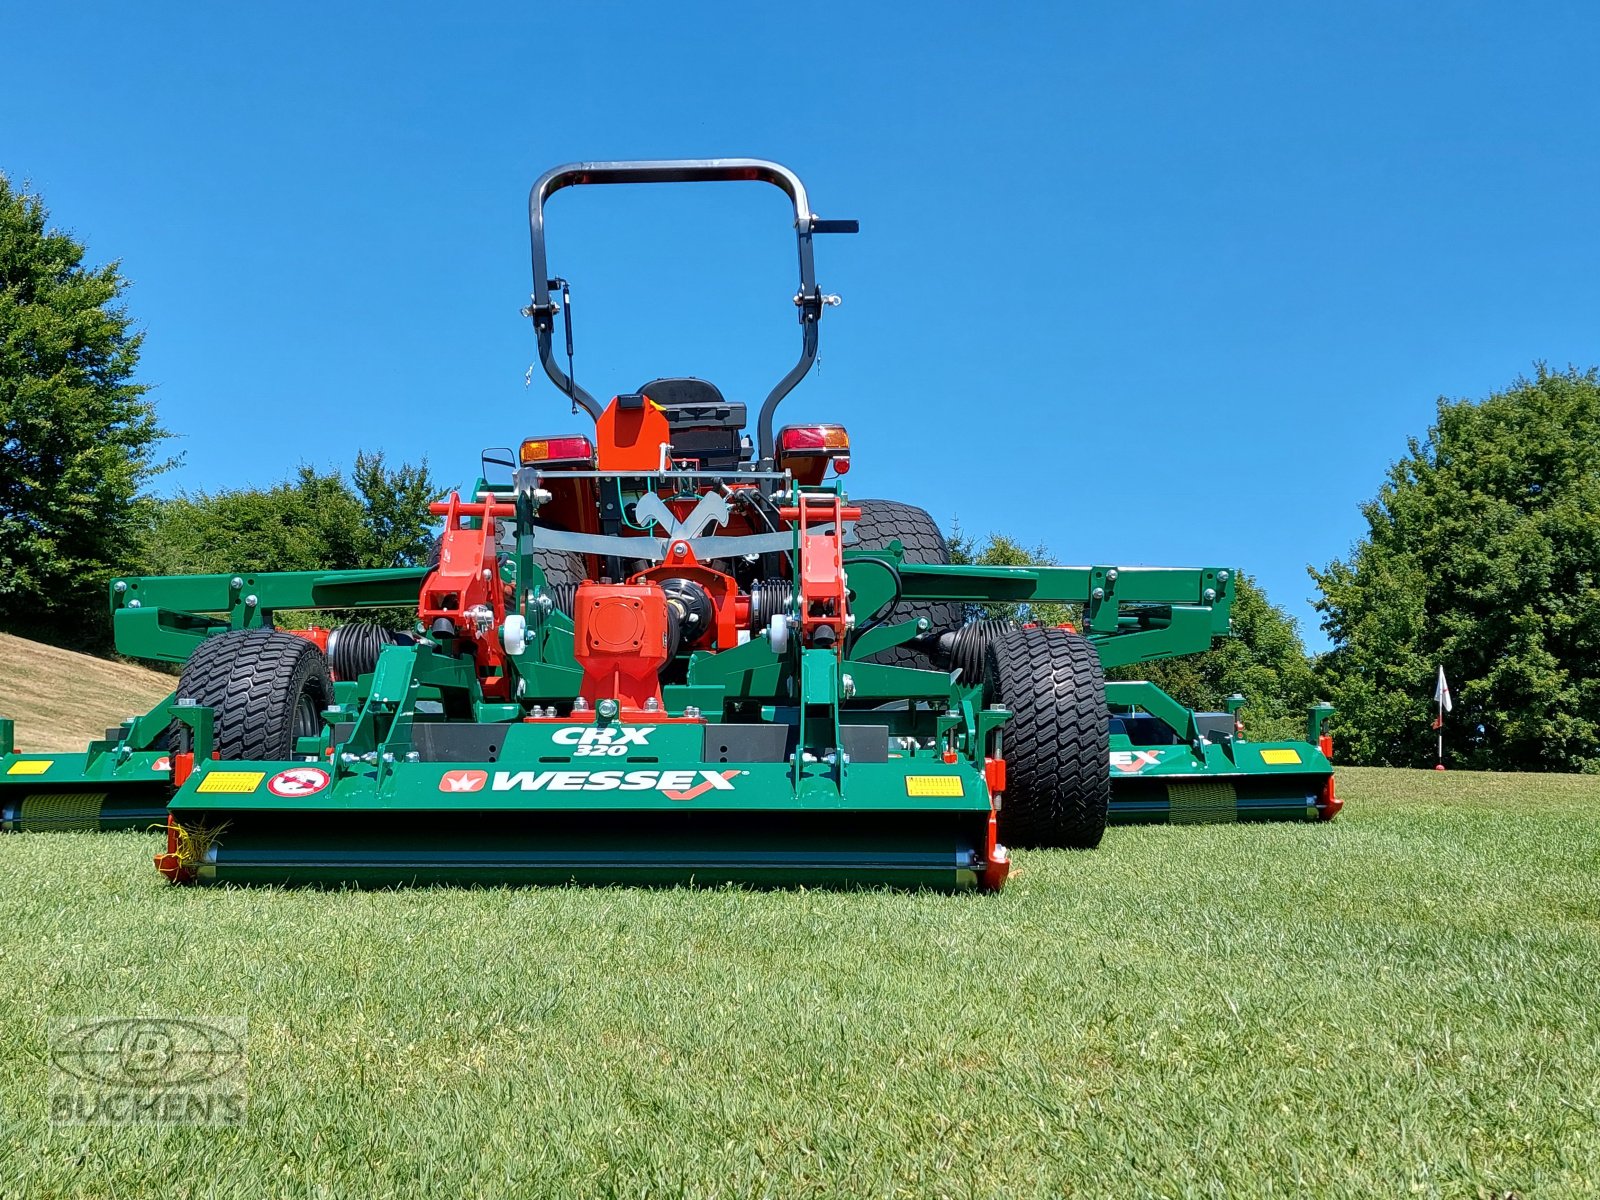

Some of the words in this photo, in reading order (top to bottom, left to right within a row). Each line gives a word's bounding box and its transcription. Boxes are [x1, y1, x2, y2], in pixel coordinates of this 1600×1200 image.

[551, 727, 656, 745] CRX
[572, 744, 628, 757] 320
[492, 770, 740, 799] WESSEX
